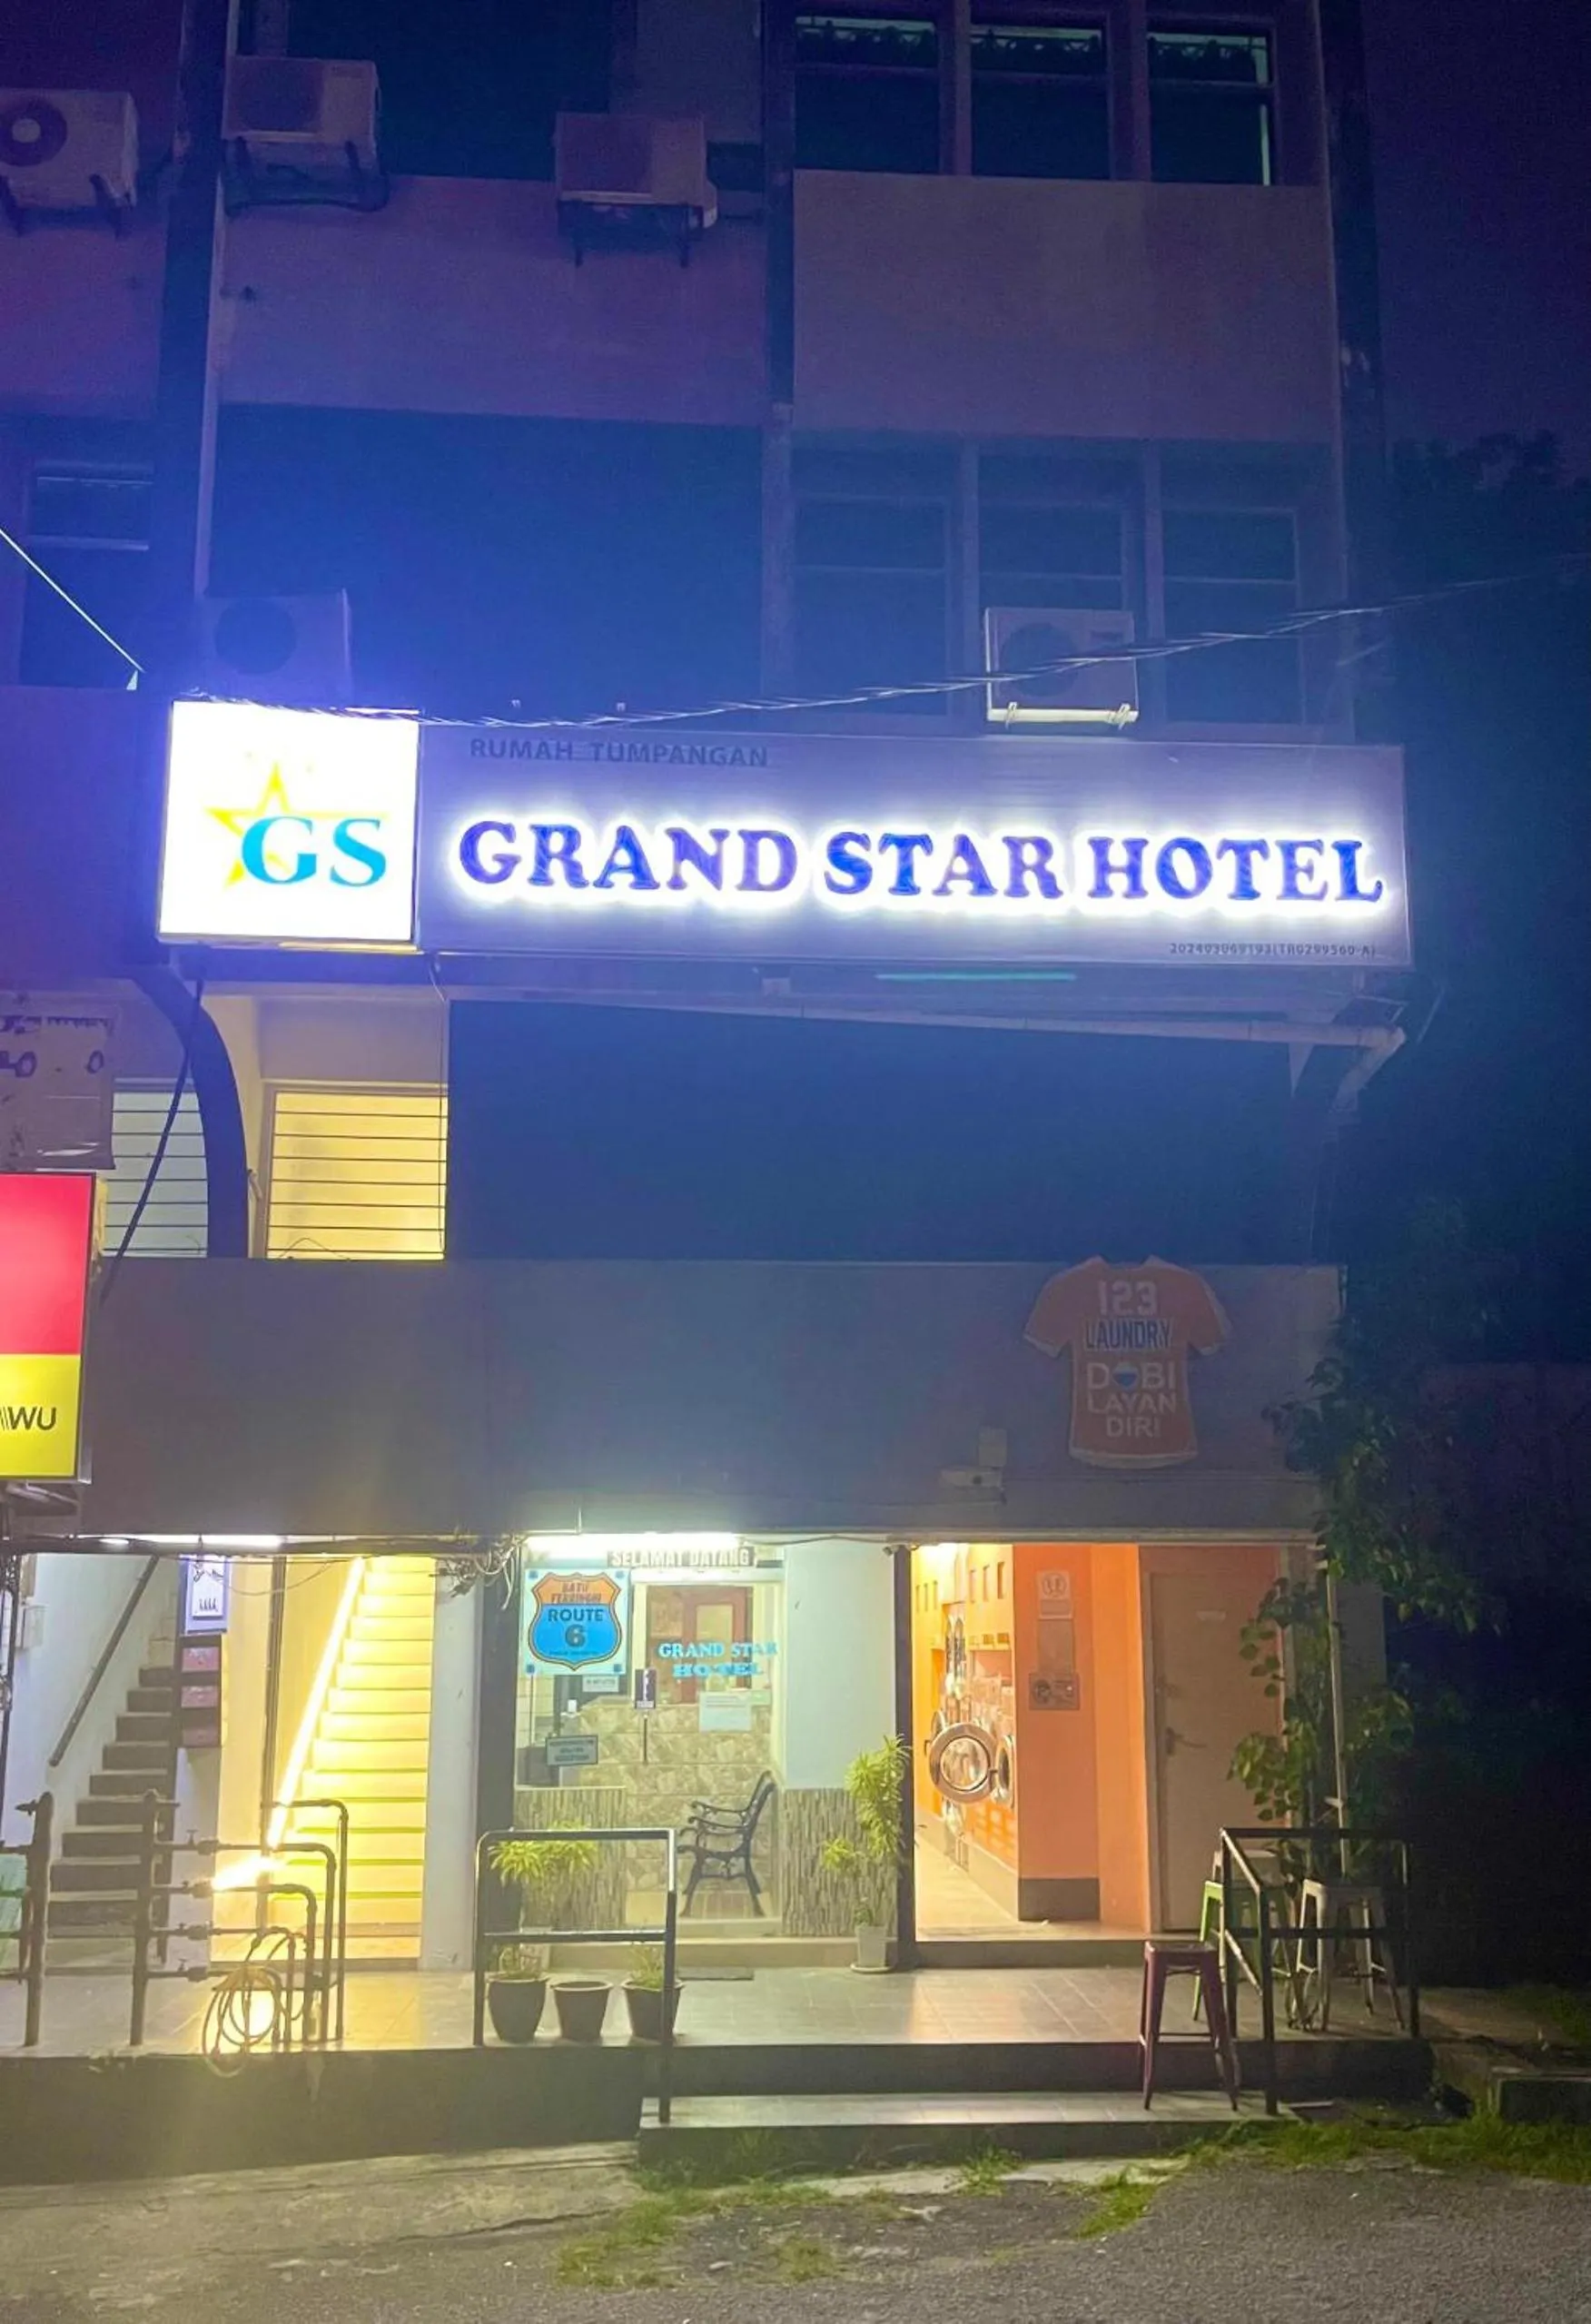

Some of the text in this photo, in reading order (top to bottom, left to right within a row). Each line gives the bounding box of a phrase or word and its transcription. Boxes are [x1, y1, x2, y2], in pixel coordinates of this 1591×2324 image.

[470, 738, 768, 767] RUMAH TUMPANGAN
[242, 816, 387, 887] GS
[459, 820, 1383, 903] GRAND STAR HOTEL
[1098, 1280, 1158, 1316] 123
[1085, 1319, 1172, 1350] LAUNDRY
[1087, 1391, 1177, 1415] LAYAN
[1105, 1416, 1161, 1439] DIRI
[611, 1547, 751, 1567] SELAMAT DATANG
[548, 1608, 604, 1622] ROUTE
[565, 1624, 587, 1647] 6
[657, 1642, 778, 1658] GRAND STAR
